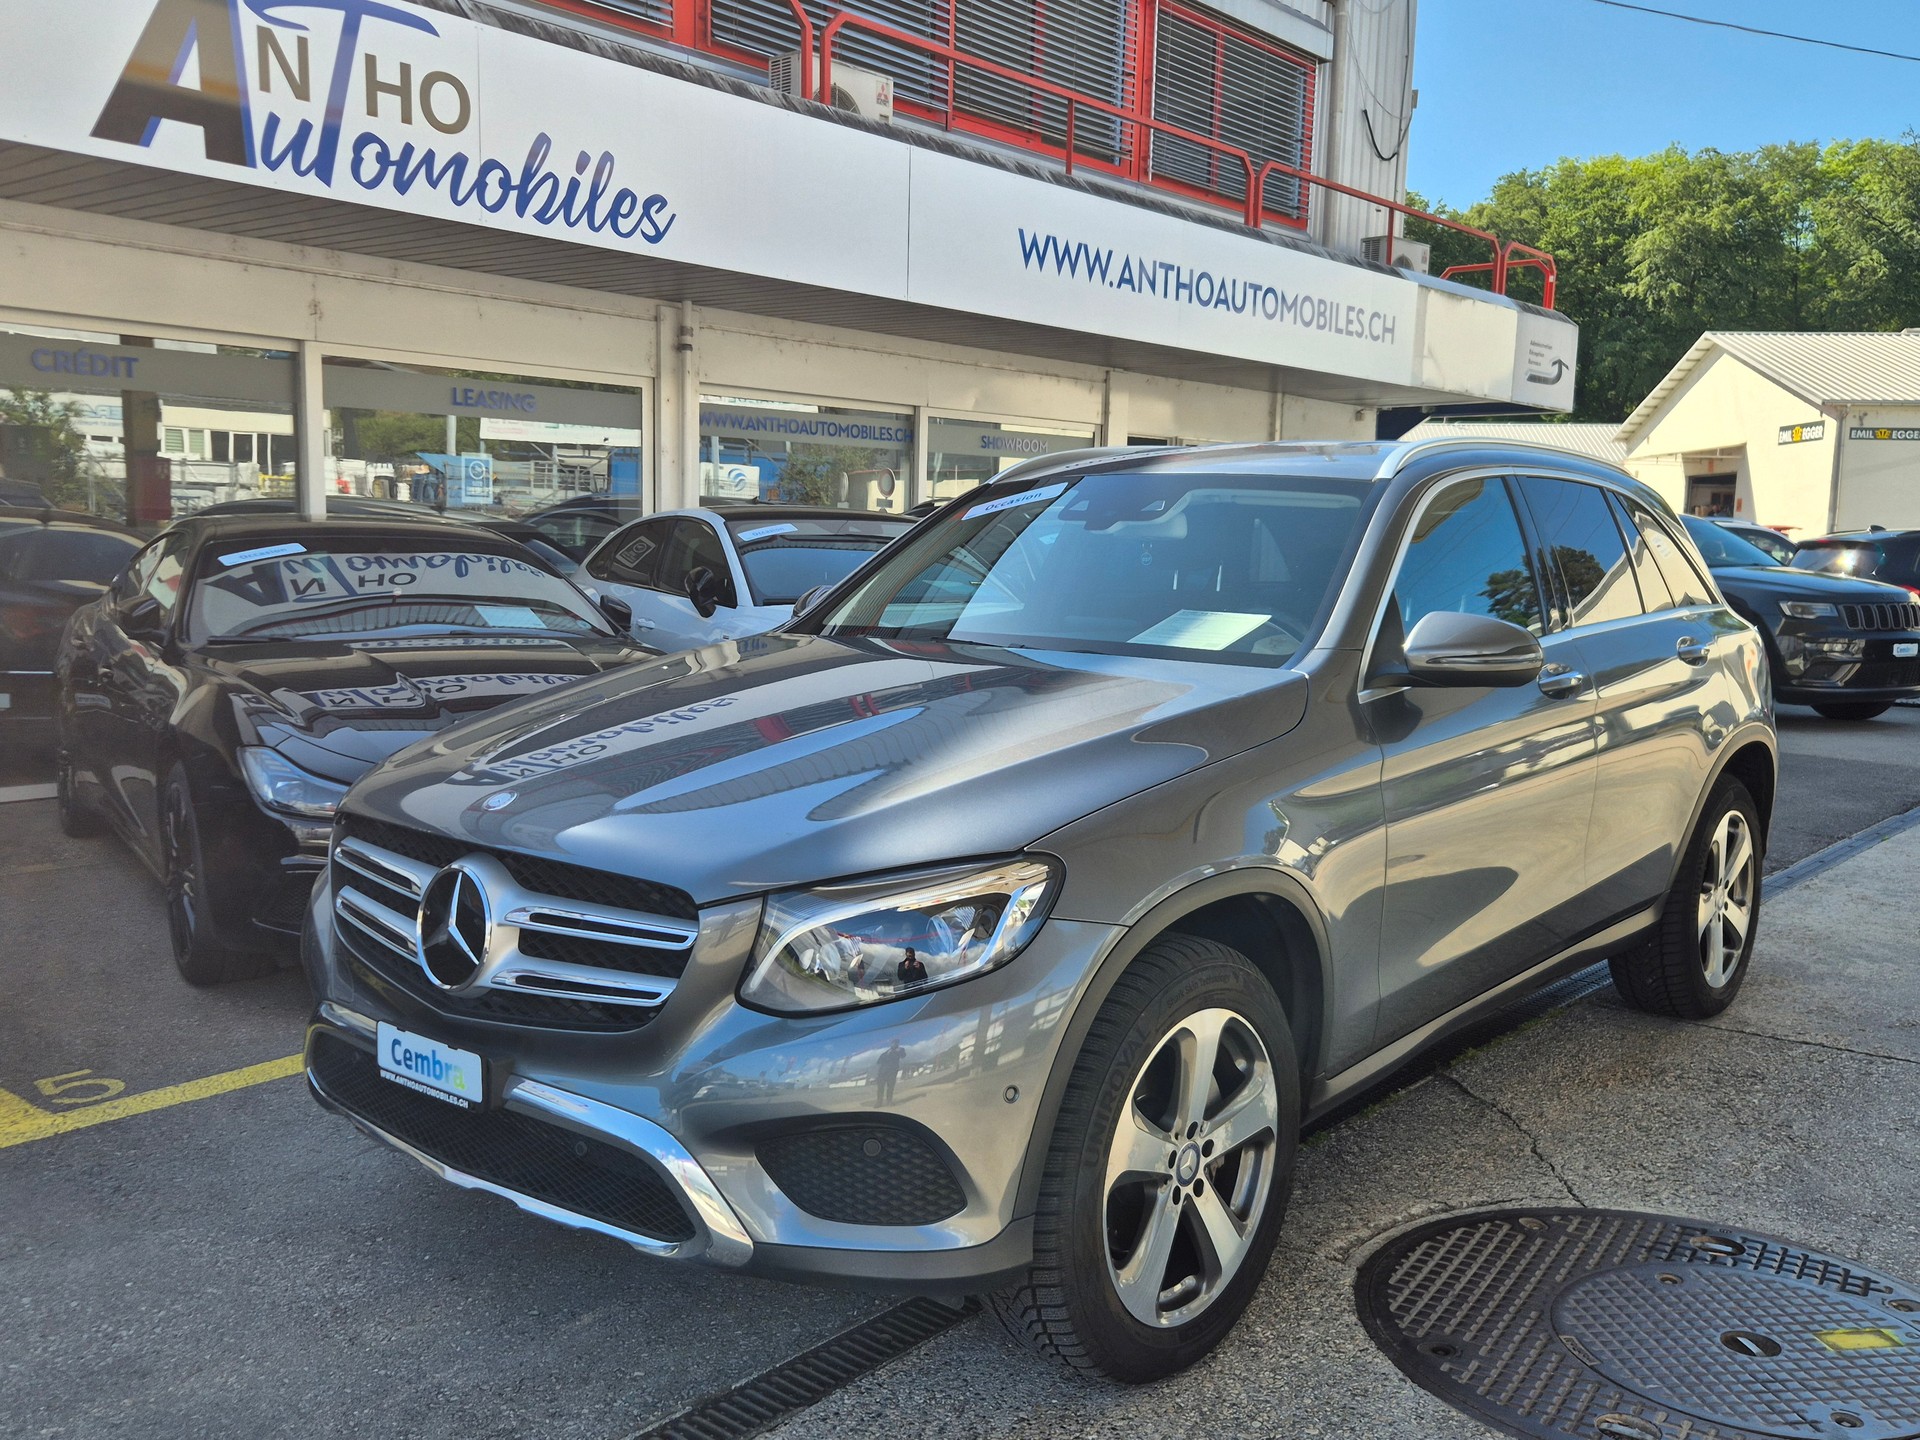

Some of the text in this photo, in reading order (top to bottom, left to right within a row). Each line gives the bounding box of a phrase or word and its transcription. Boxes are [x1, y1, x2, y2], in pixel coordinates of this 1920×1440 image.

[1018, 228, 1396, 346] WWW.ANTHOAUTOMOBILES.CH
[31, 347, 139, 379] CRÉDIT
[451, 387, 537, 413] LEASING
[699, 410, 915, 443] WWW.ANTHOAUTOMOBILES.CH
[1779, 426, 1823, 444] EMIL EGGER
[1851, 430, 1920, 439] EMIL EGGE
[981, 435, 1048, 453] SHOWROOM
[985, 493, 1042, 511] Occasion
[391, 1038, 468, 1090] Cembra
[33, 1069, 126, 1104] 5
[380, 1069, 469, 1109] WWW.ANTHOAUTOMOBILES.CH
